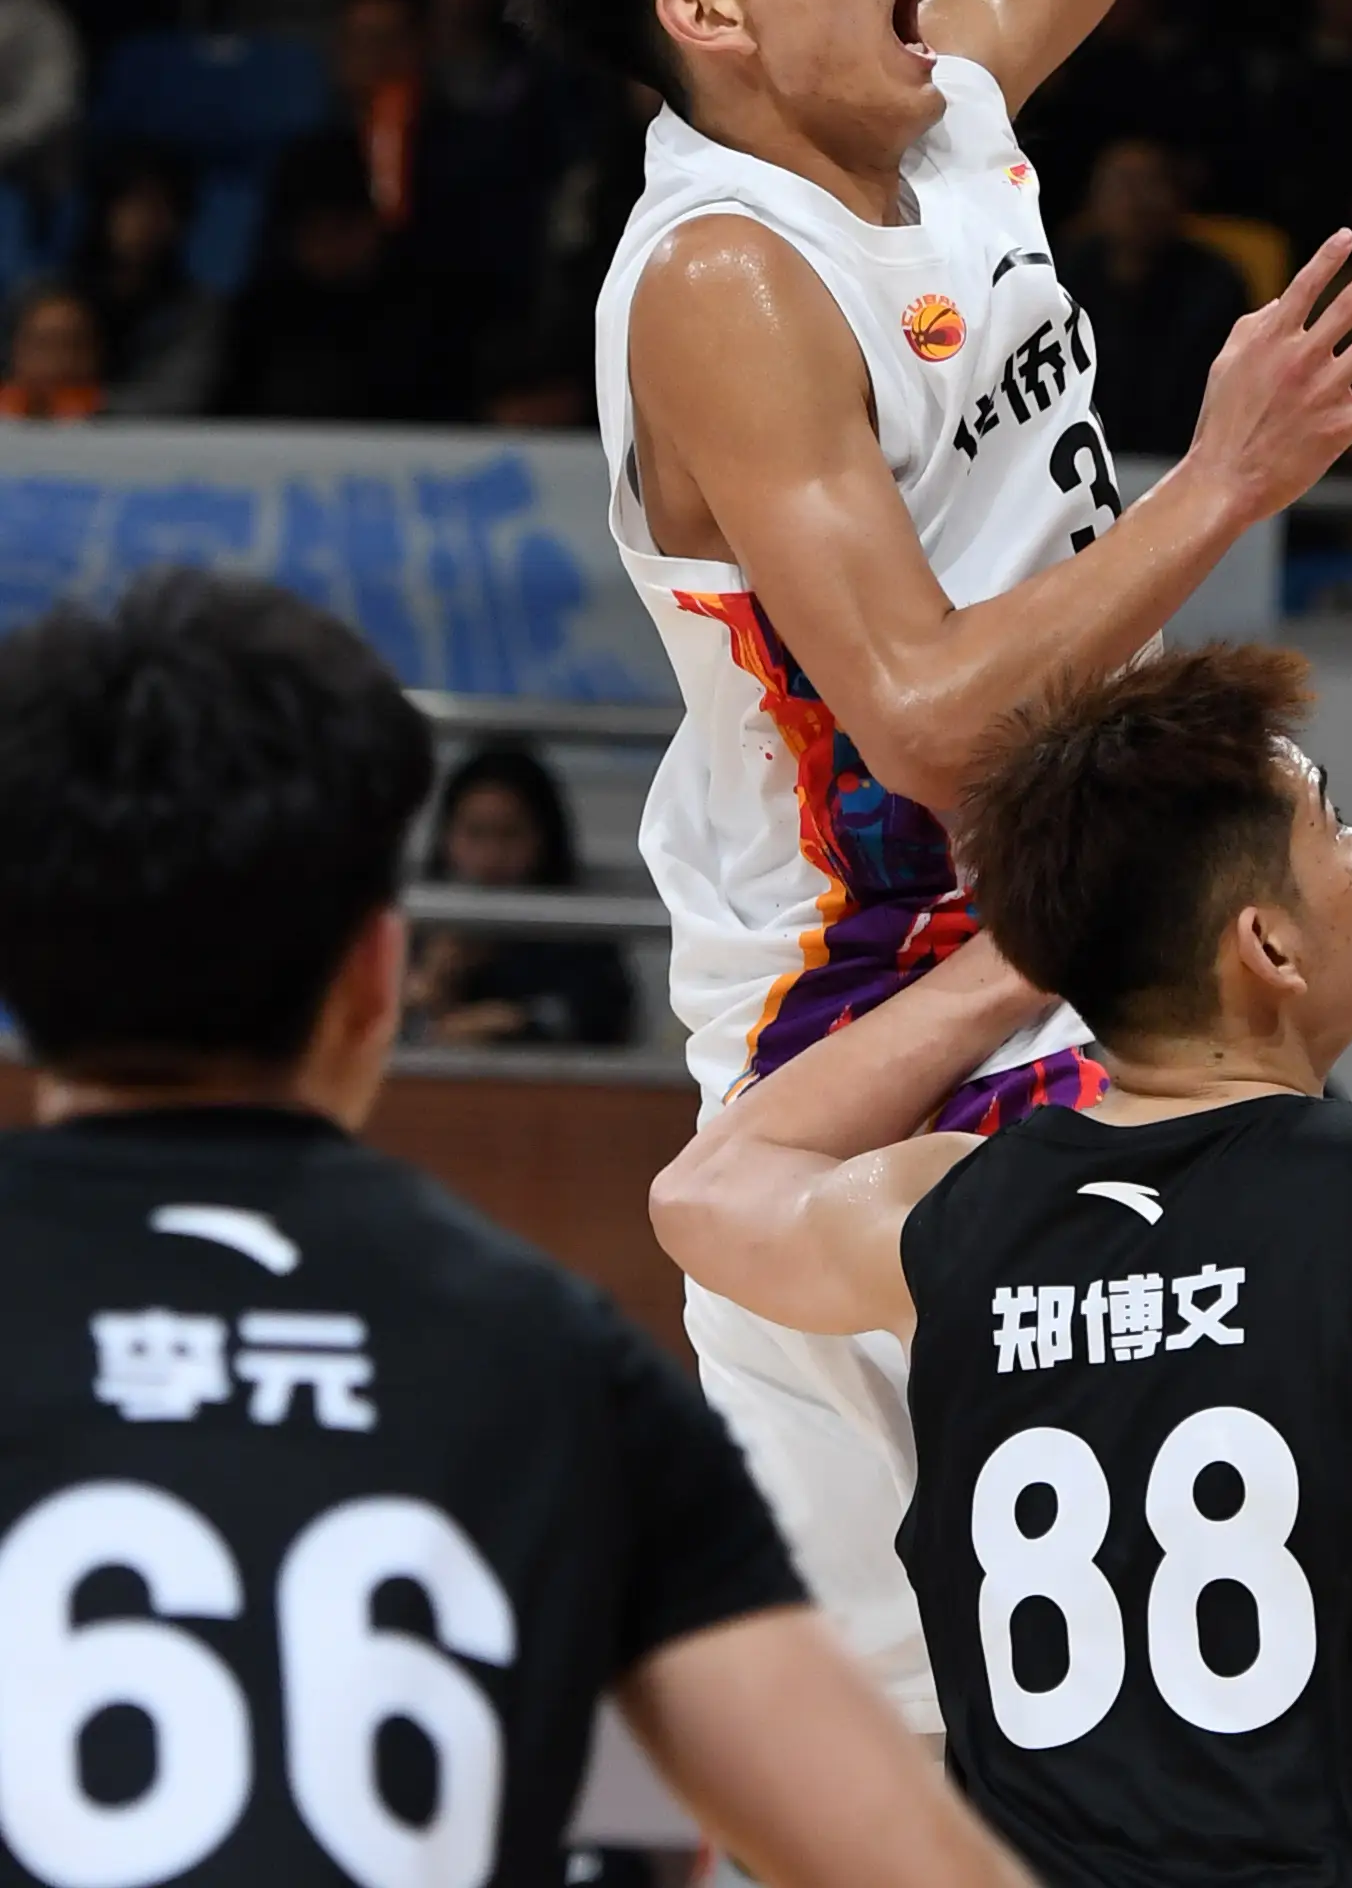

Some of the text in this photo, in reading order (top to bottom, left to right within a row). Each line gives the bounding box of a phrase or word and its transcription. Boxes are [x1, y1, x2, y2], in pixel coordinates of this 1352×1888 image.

[992, 1263, 1246, 1374] 郑博文
[0, 1477, 520, 1888] 66
[971, 1405, 1318, 1750] 88
